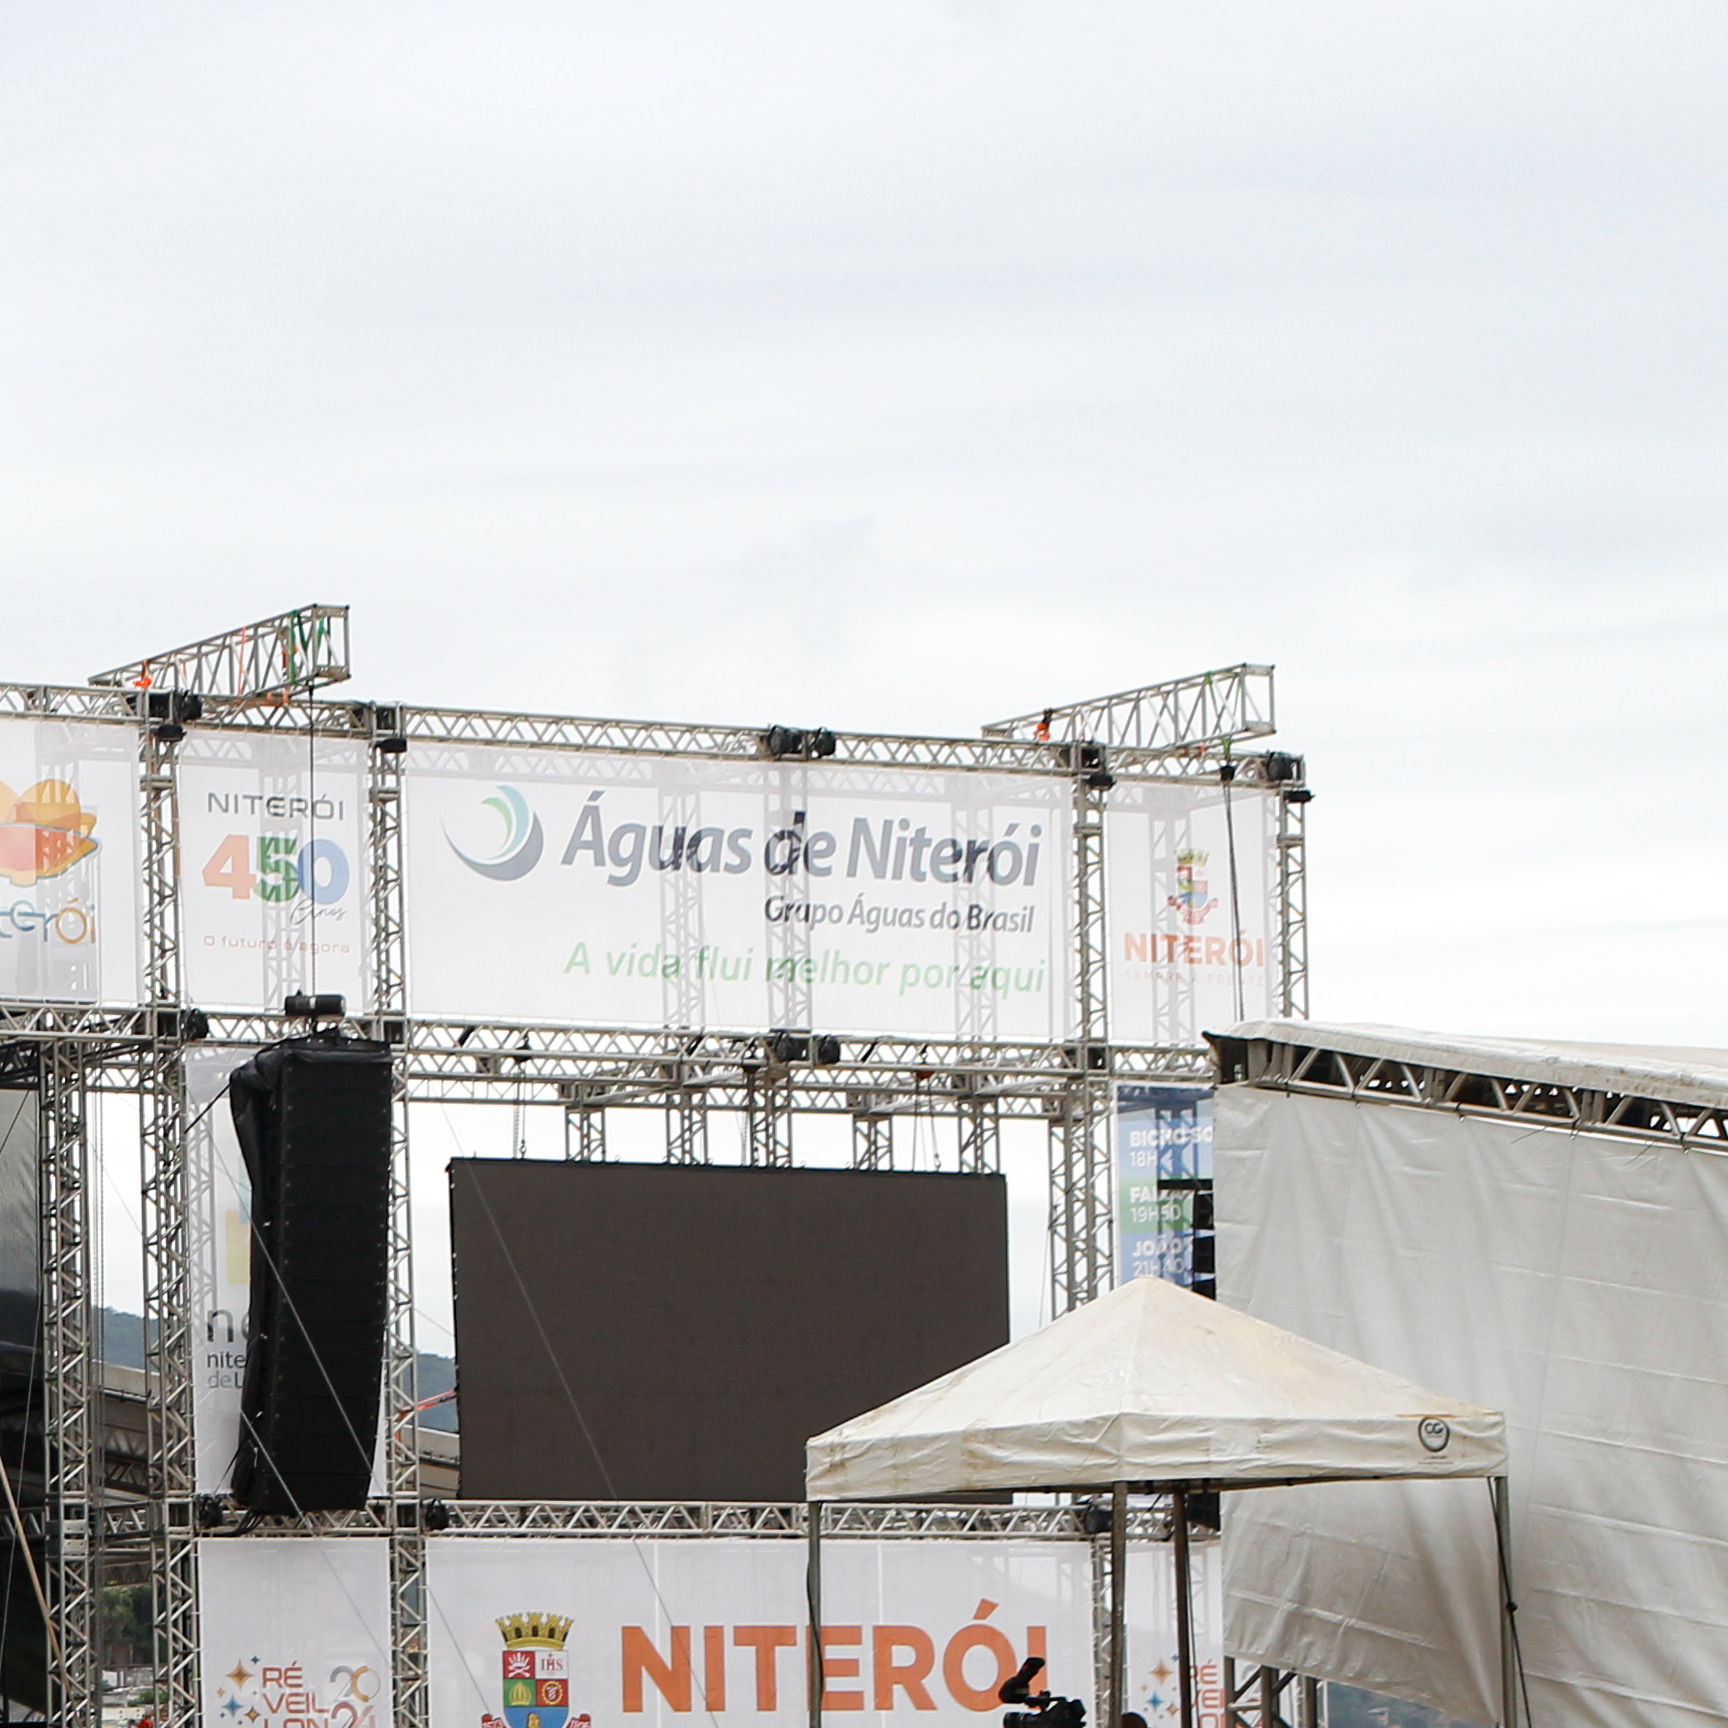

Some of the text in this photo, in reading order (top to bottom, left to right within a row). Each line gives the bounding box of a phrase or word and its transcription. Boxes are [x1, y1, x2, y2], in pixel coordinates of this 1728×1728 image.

[208, 792, 343, 821] NITERÓI
[560, 789, 1042, 888] Águas de Niterói
[202, 834, 350, 905] 450
[764, 891, 1033, 935] Grupo Águas do Brasil
[204, 935, 215, 946] O
[222, 935, 278, 950] futuro
[299, 942, 350, 954] agora
[1124, 929, 1265, 967] NITERÓI
[563, 941, 1046, 997] A vida flui melhor por aqui
[1130, 1203, 1182, 1224] 19H50
[262, 1659, 303, 1688] RÉ
[621, 1598, 1047, 1712] NITERÓI
[262, 1693, 330, 1715] VEIL
